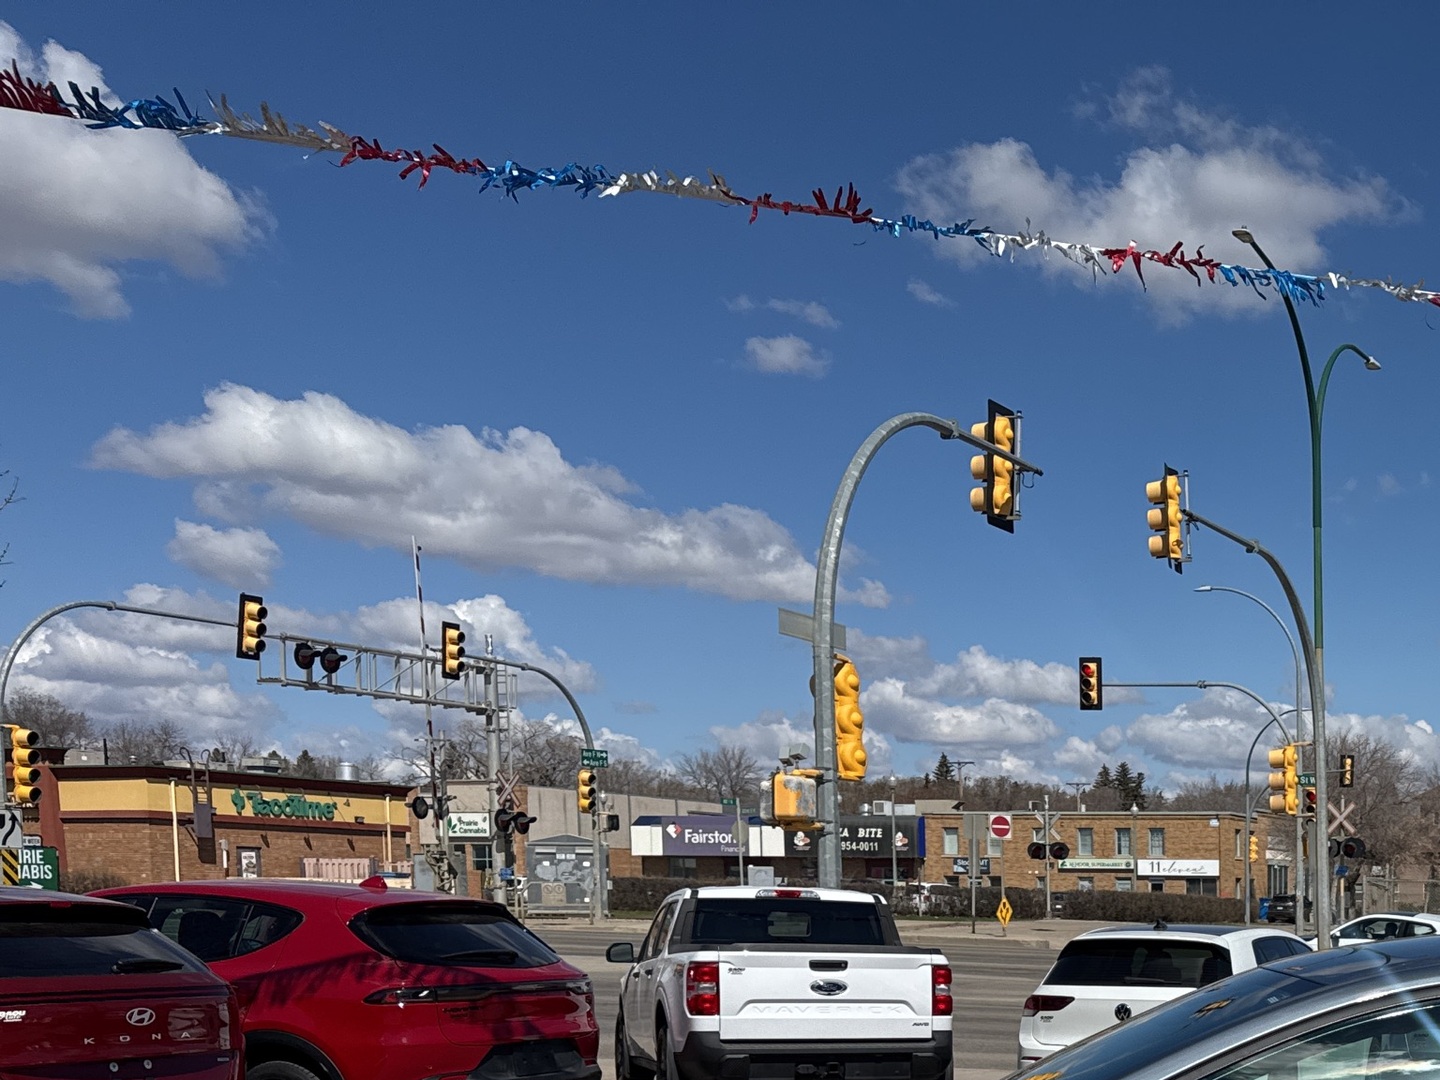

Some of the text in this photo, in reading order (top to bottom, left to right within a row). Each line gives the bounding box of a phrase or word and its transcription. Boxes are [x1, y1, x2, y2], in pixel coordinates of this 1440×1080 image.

[246, 792, 335, 820] TacoTime
[684, 829, 738, 844] Fairston
[858, 828, 883, 838] BITE
[841, 841, 878, 851] 954-0011
[1149, 861, 1160, 873] 11
[752, 1005, 904, 1015] MAVERICK
[84, 1031, 191, 1045] KONA
